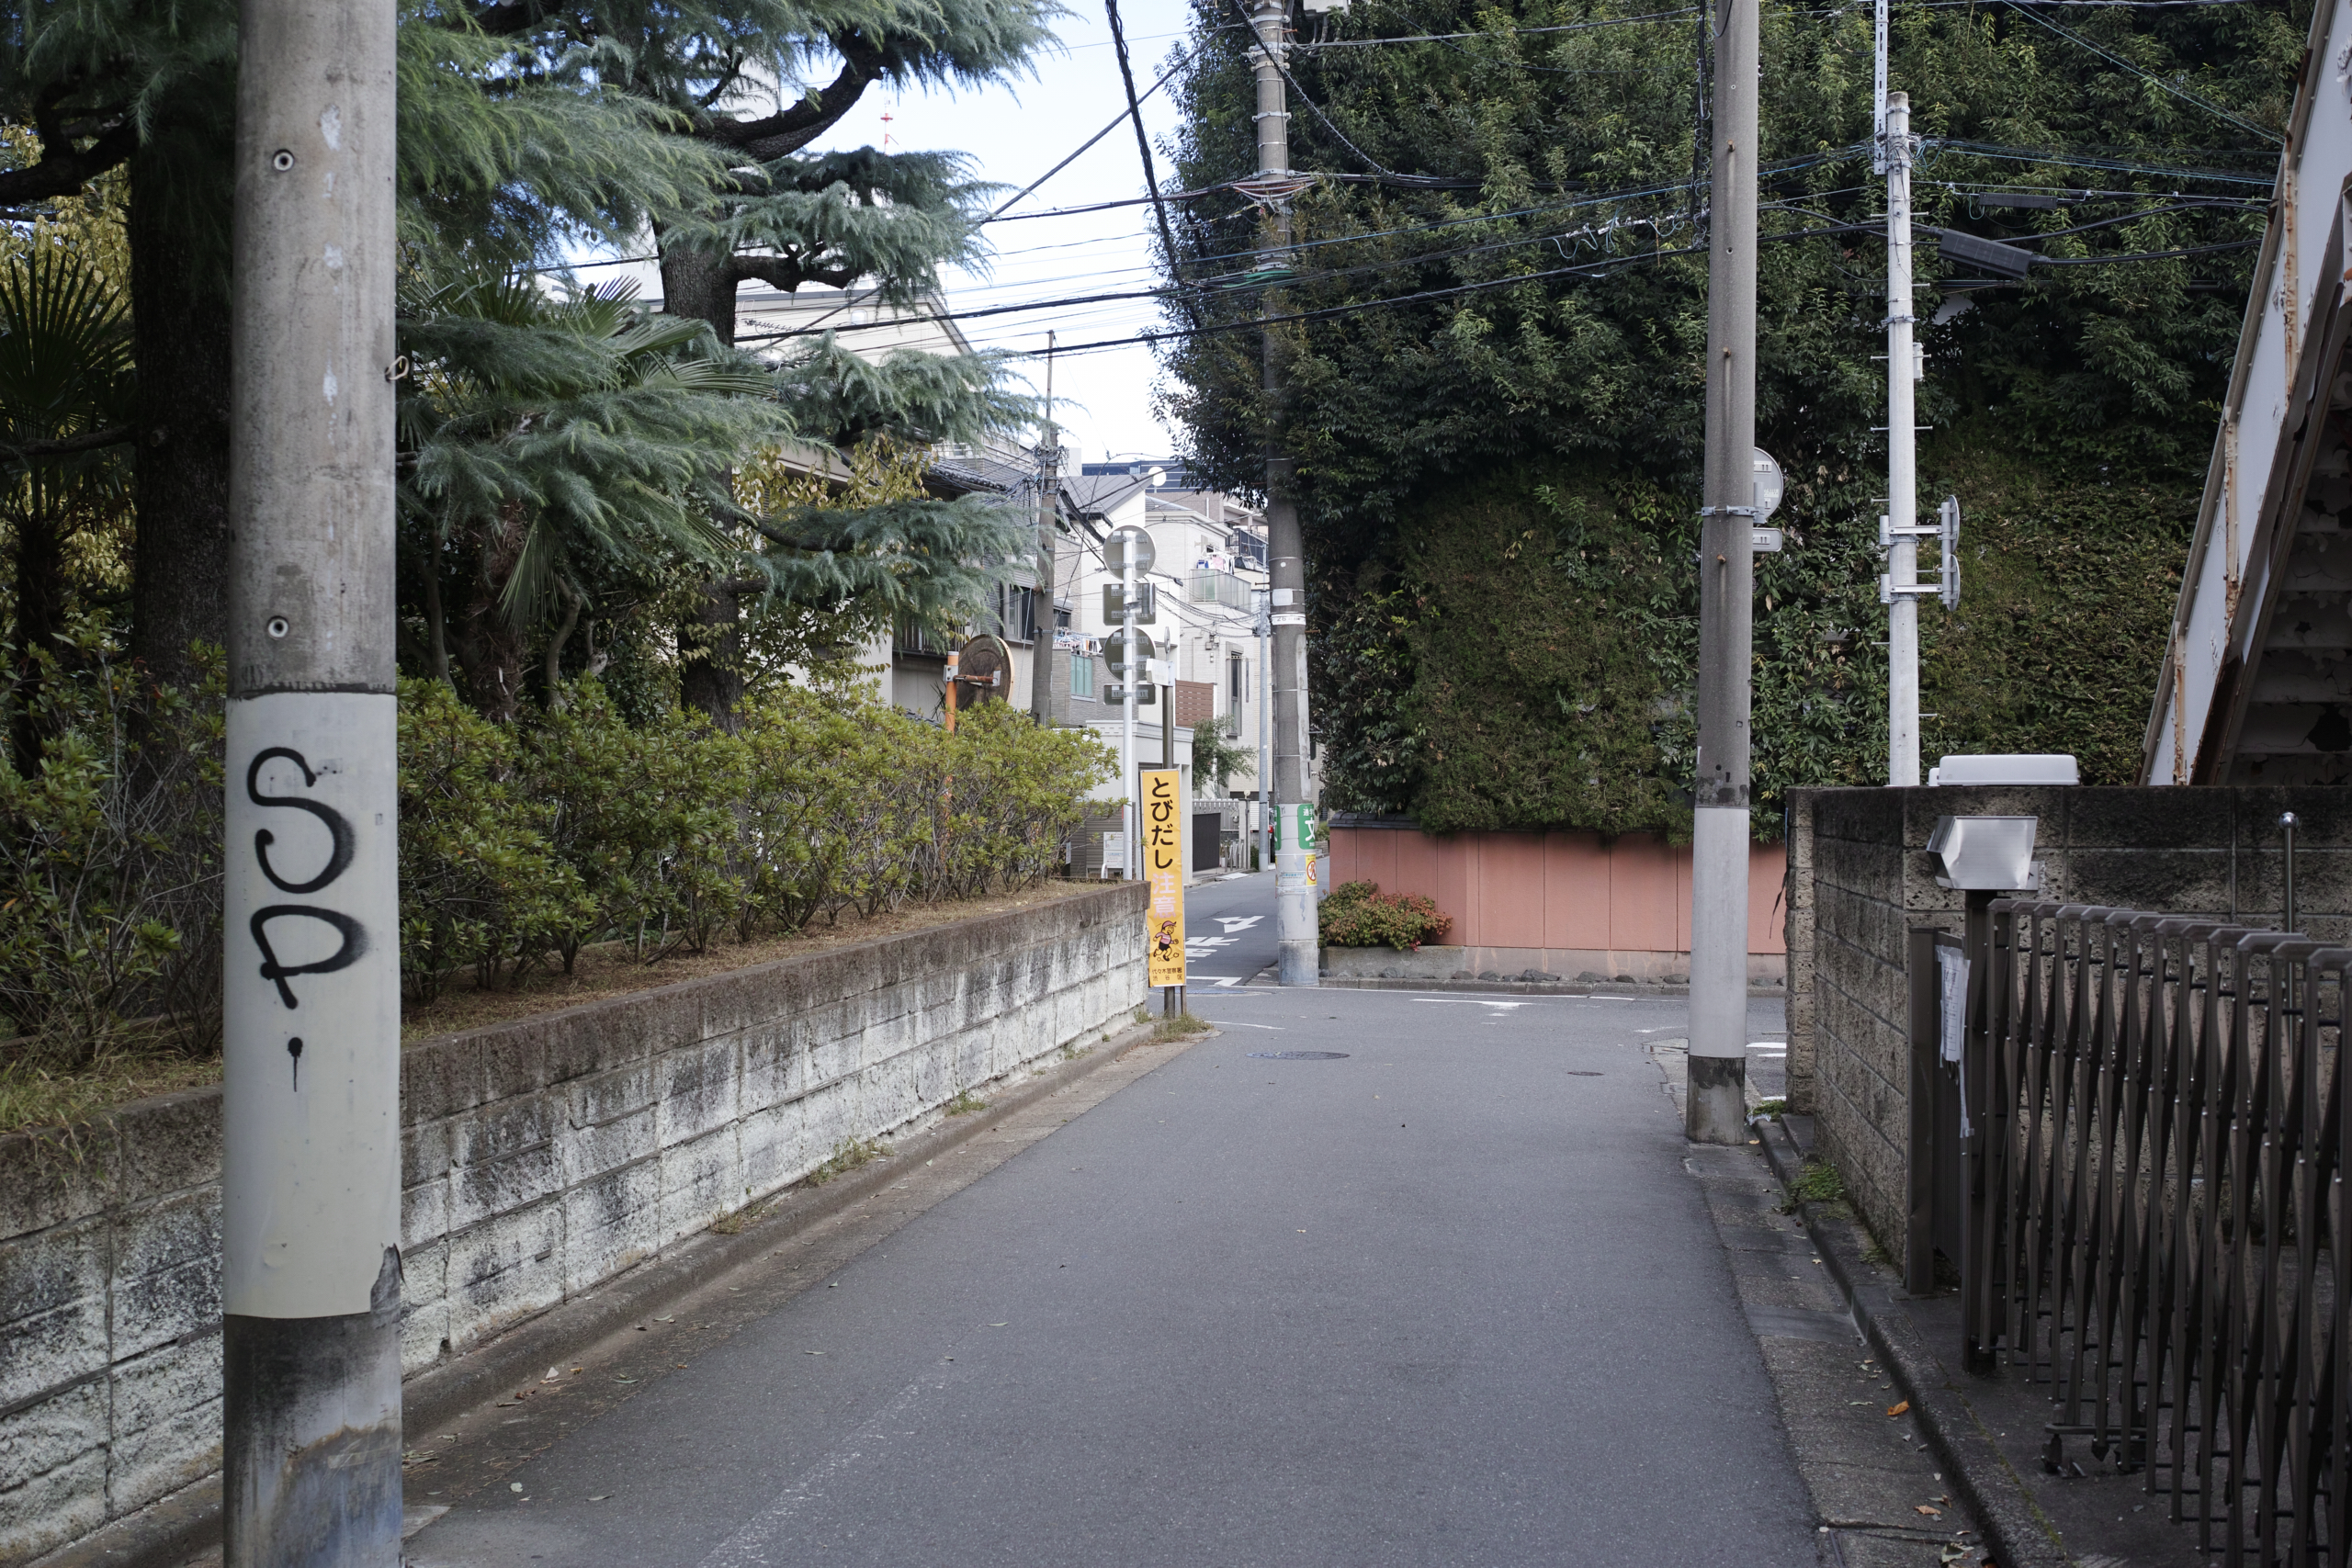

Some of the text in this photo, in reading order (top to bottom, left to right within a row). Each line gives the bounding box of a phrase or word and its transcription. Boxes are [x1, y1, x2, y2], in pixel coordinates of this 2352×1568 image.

[1150, 777, 1176, 918] とびだし注意
